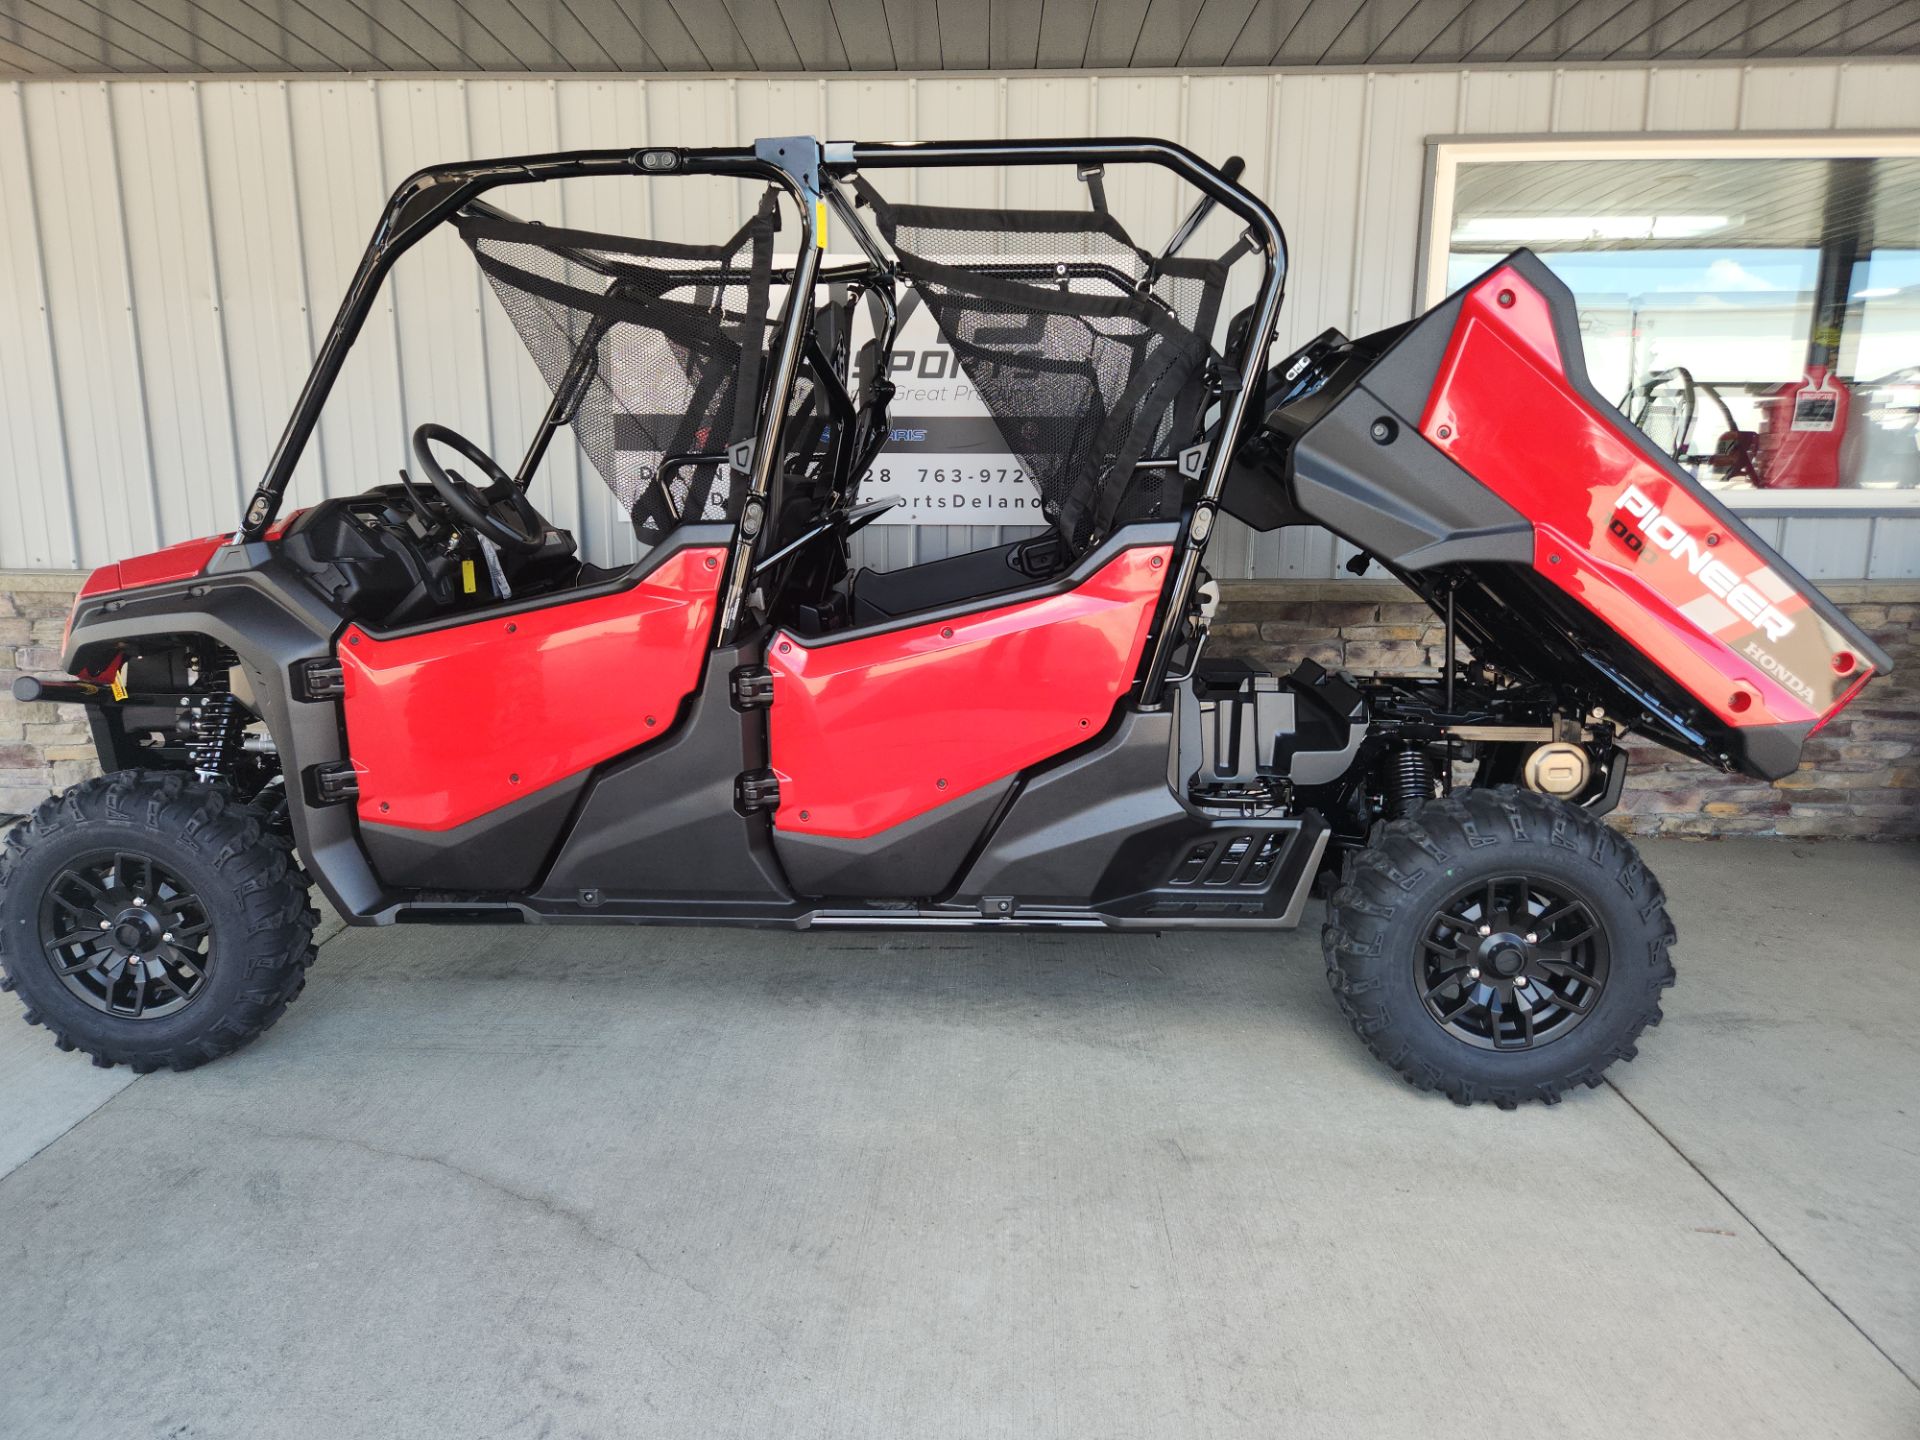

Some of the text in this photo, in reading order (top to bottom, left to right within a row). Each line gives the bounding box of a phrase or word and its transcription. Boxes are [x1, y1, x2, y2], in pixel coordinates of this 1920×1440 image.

[892, 385, 948, 401] Great
[918, 469, 1025, 482] 763-972
[1614, 484, 1795, 642] PIONEER
[1743, 641, 1815, 704] HONDA
